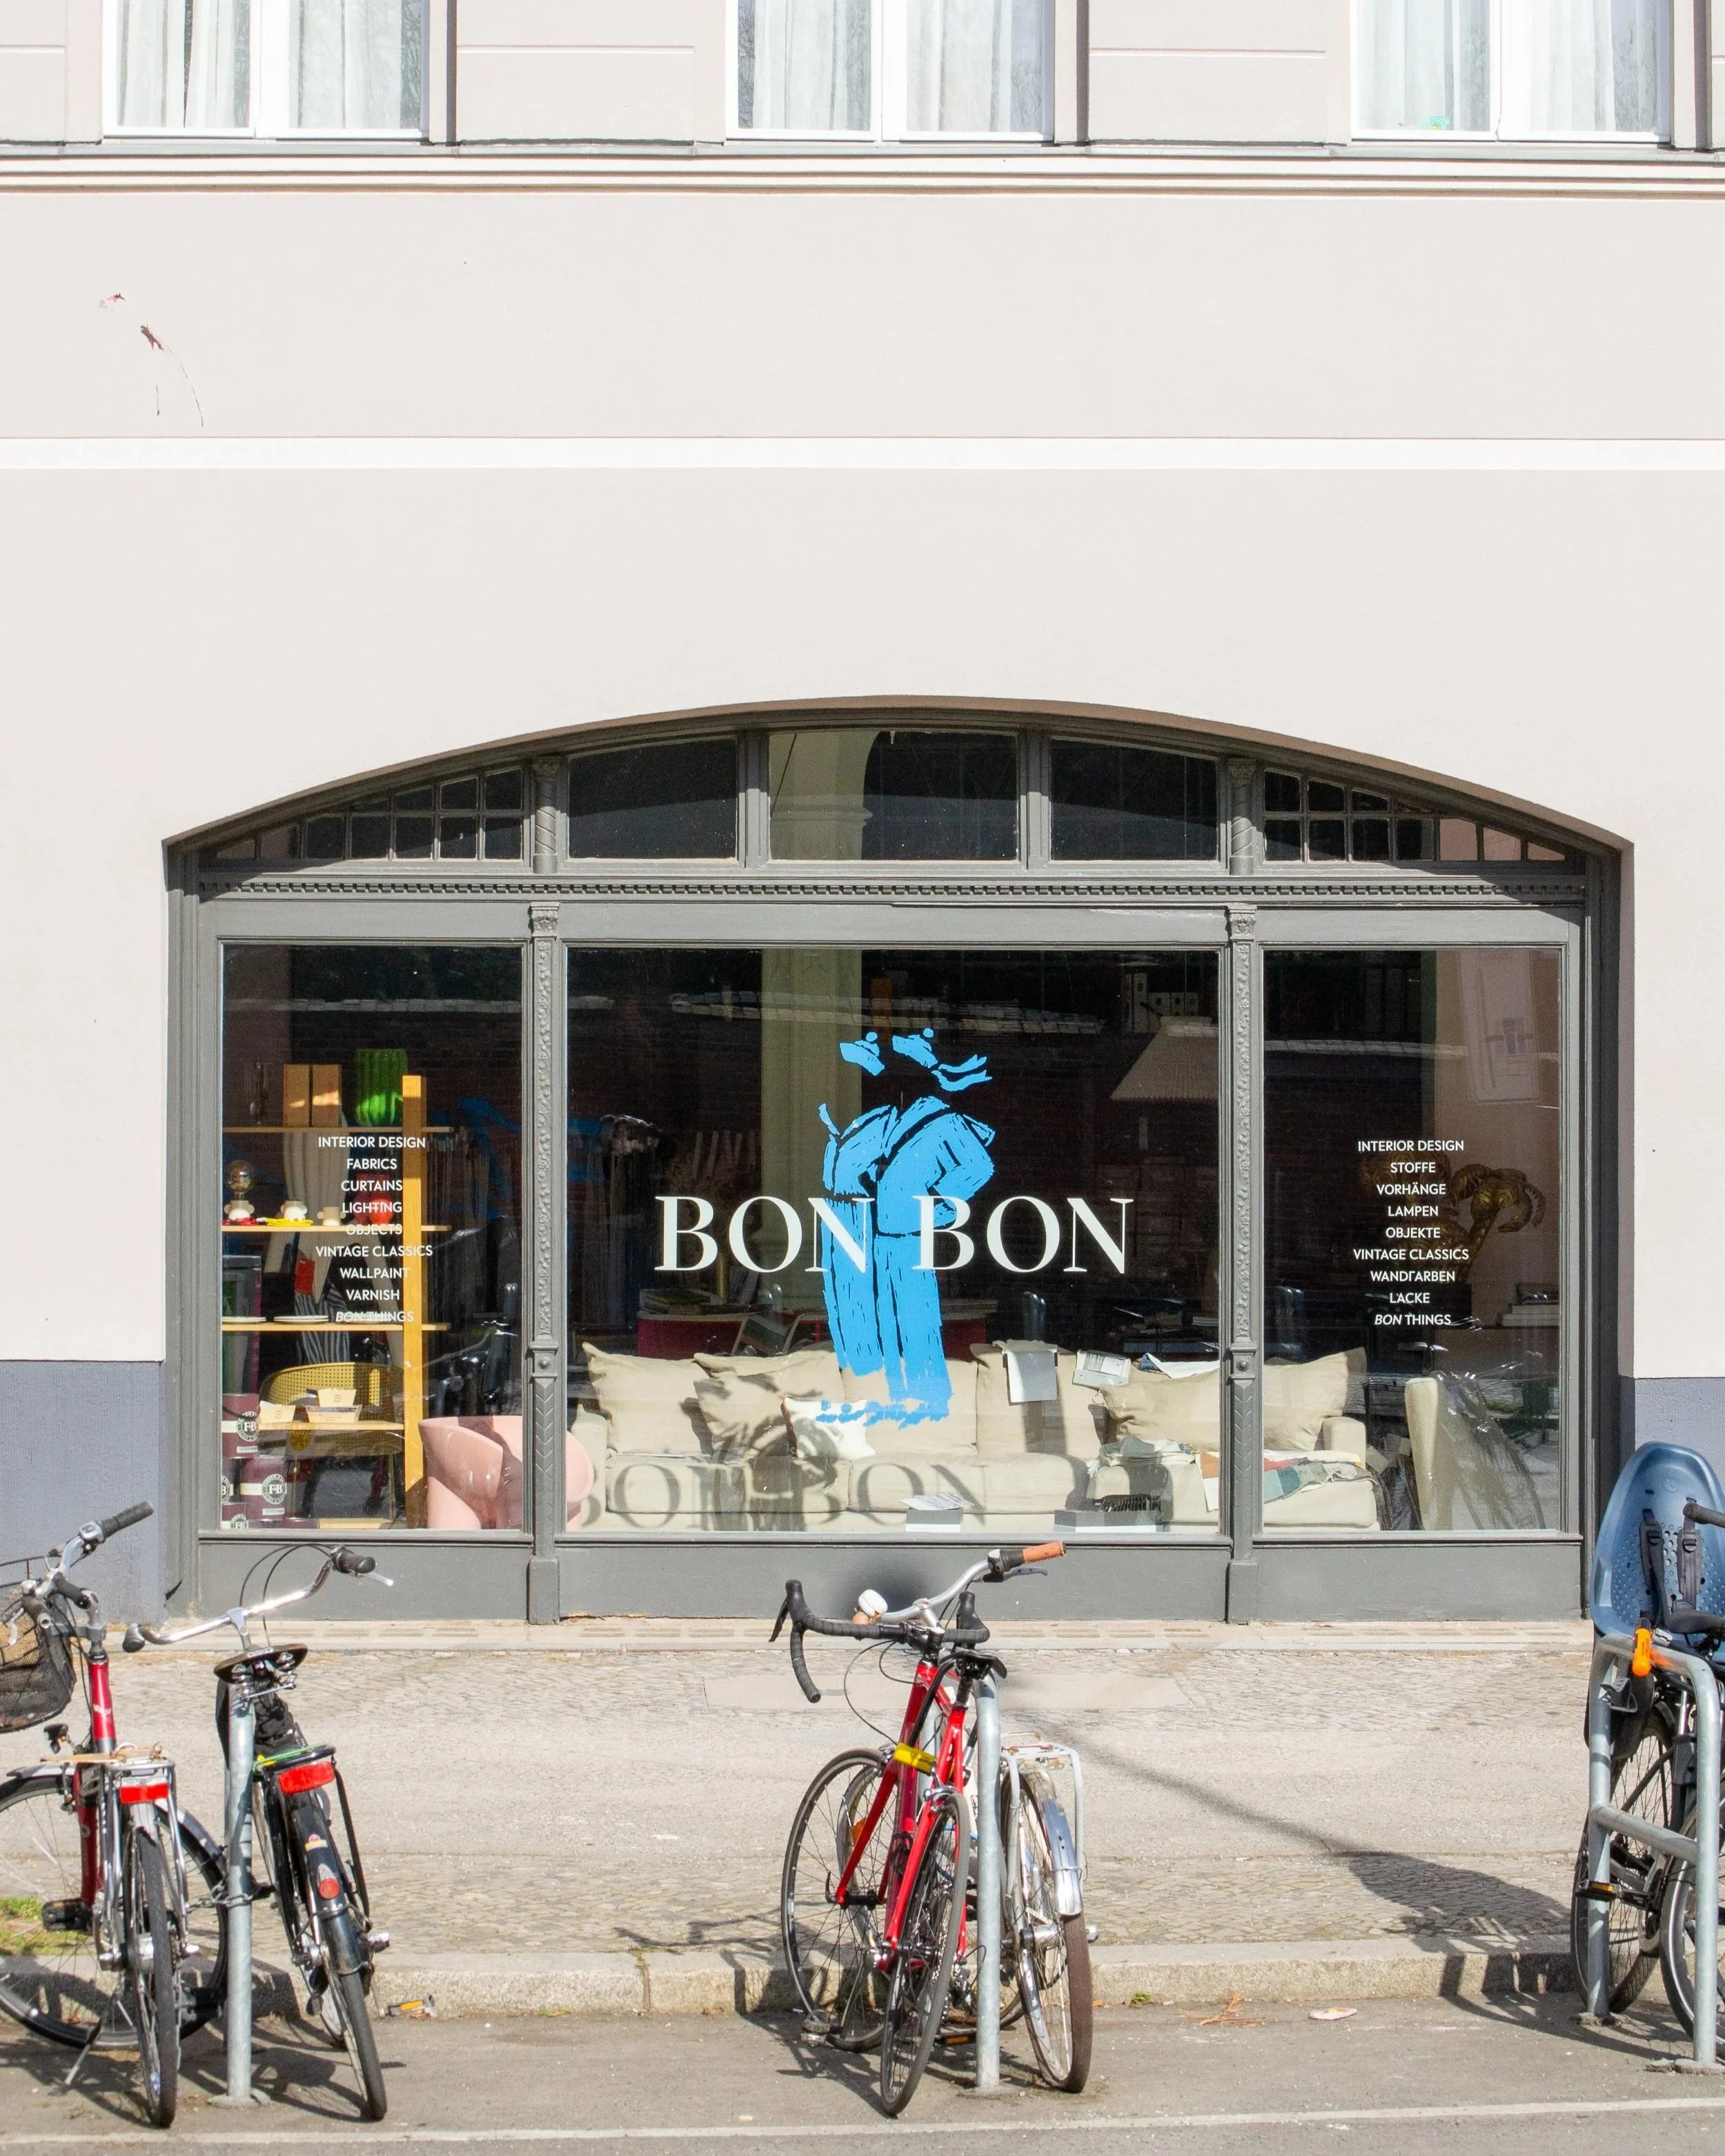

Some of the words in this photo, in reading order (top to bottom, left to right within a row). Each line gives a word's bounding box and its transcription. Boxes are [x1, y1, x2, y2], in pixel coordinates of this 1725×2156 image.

[318, 1136, 375, 1148] INTERIOR
[379, 1136, 426, 1148] DESIGN
[1357, 1140, 1414, 1151] INTERIOR
[1417, 1140, 1464, 1151] DESIGN
[346, 1158, 397, 1170] FABRICS
[1390, 1162, 1436, 1174] STOFFE
[341, 1180, 403, 1191] CURTAINS
[1376, 1182, 1446, 1195] VORHÄNGE
[342, 1201, 402, 1213] LIGHTING
[1388, 1205, 1439, 1217] LAMPEN
[345, 1223, 403, 1235] OBJECTS
[654, 1195, 875, 1274] BON
[911, 1195, 1134, 1274] BON
[1386, 1227, 1441, 1238] OBJEKTE
[315, 1246, 368, 1257] VINTAGE
[373, 1245, 433, 1256] CLASSICS
[1353, 1249, 1406, 1260] VINTAGE
[1409, 1249, 1469, 1260] CLASSICS
[339, 1267, 412, 1278] WALLPAINT
[1370, 1271, 1455, 1282] WANDFARBEN
[346, 1289, 400, 1300] VARNISH
[1389, 1292, 1430, 1304] LACKE
[367, 1310, 415, 1323] THINGS
[1374, 1314, 1403, 1325] BON
[1404, 1314, 1451, 1325] THINGS
